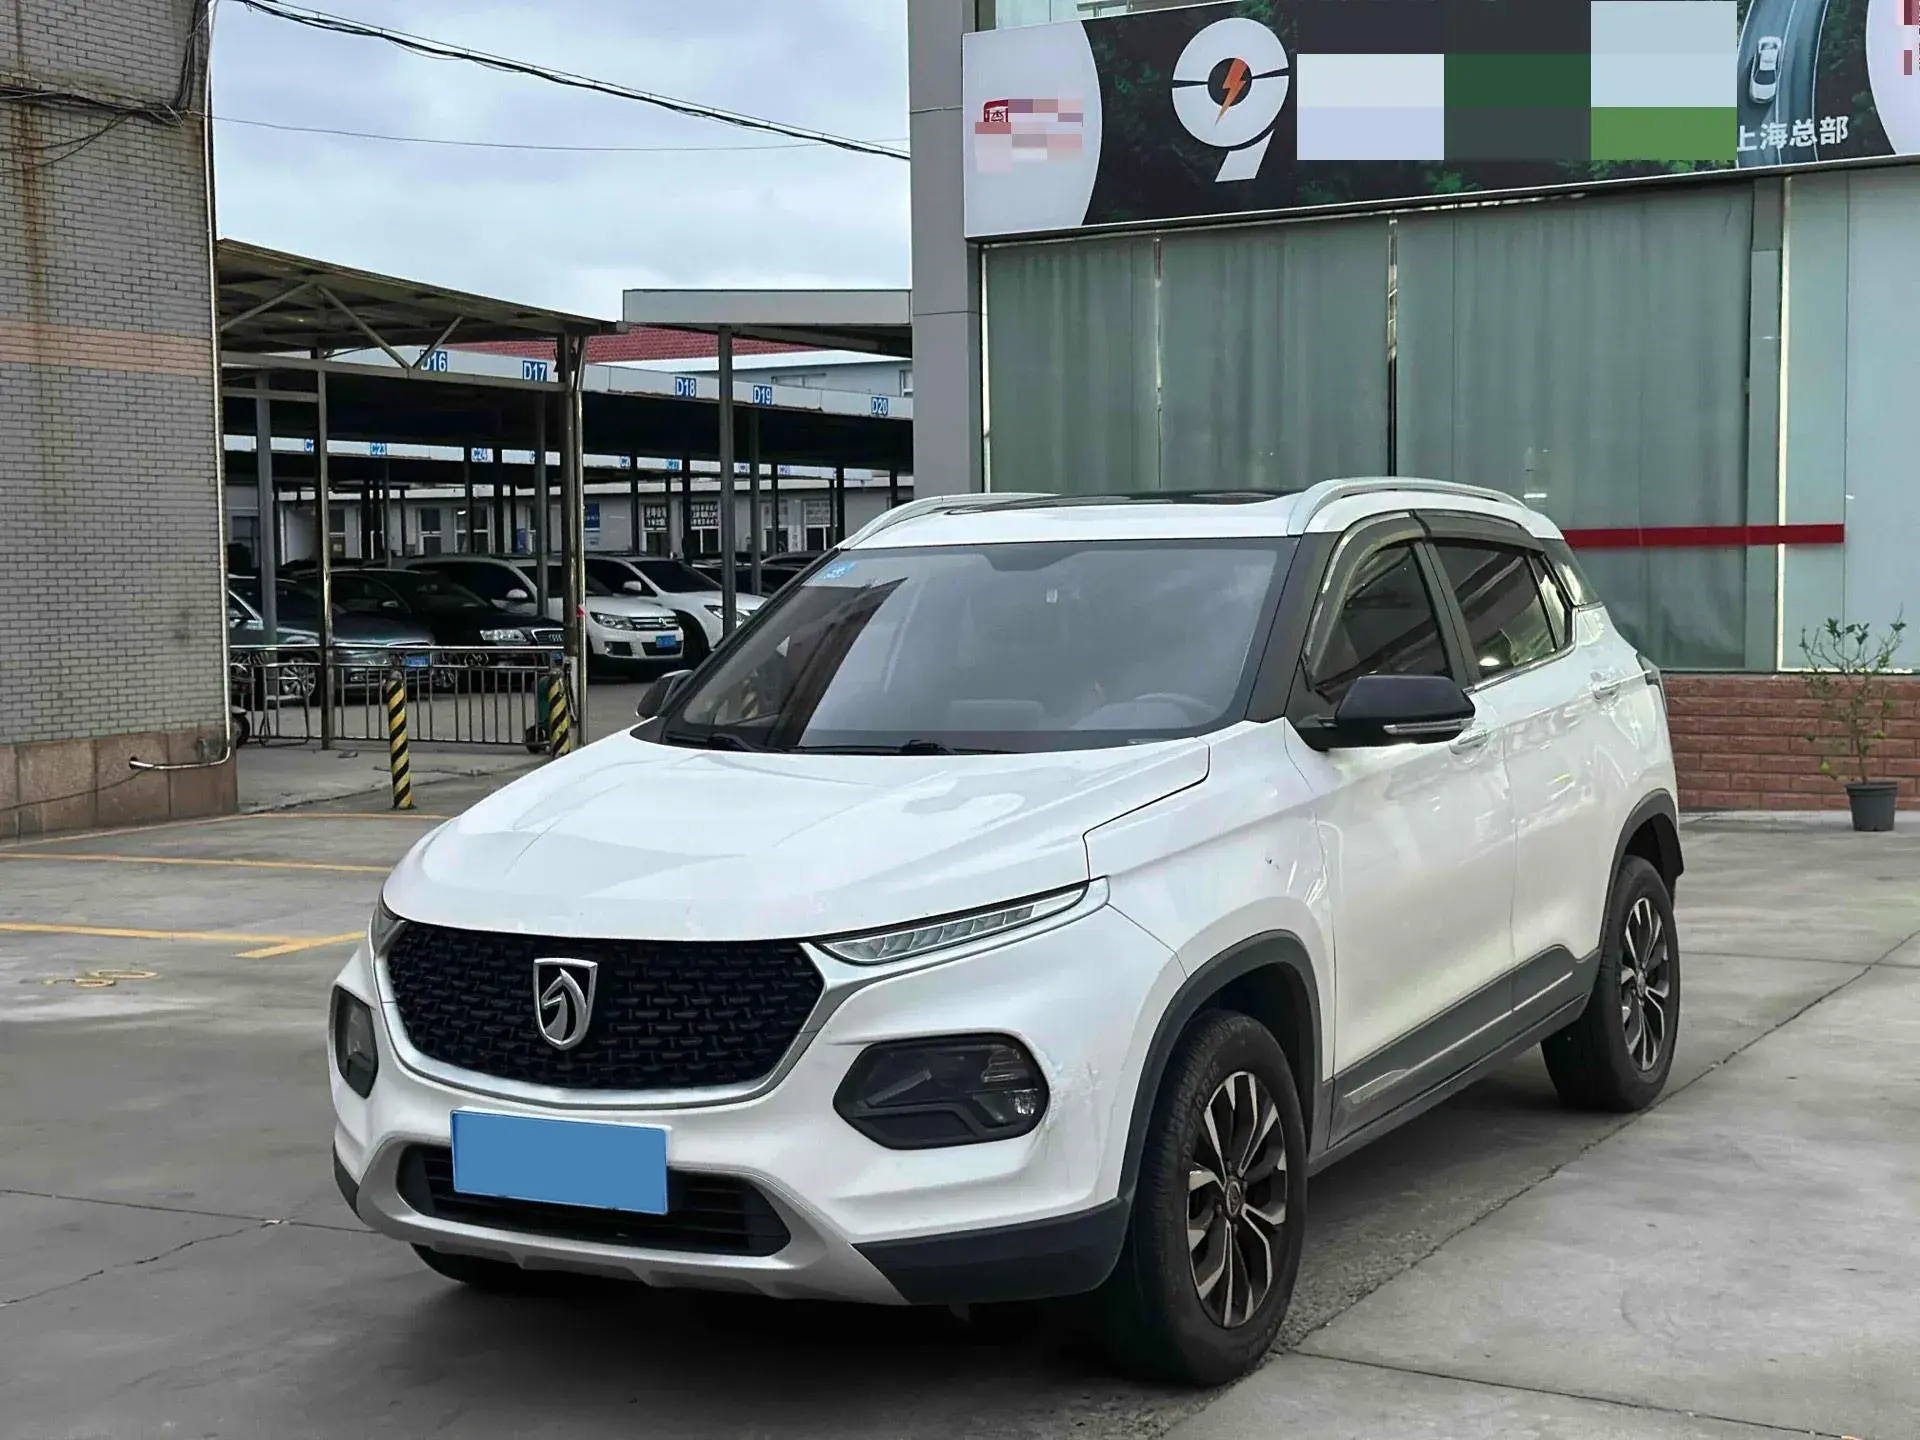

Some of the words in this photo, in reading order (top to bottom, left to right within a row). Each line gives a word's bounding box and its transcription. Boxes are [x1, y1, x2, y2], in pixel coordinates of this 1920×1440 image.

[1737, 115, 1849, 152] 上海总部
[523, 362, 546, 382] D17
[676, 378, 695, 396] D18
[754, 387, 771, 405] D19
[872, 398, 888, 415] D20
